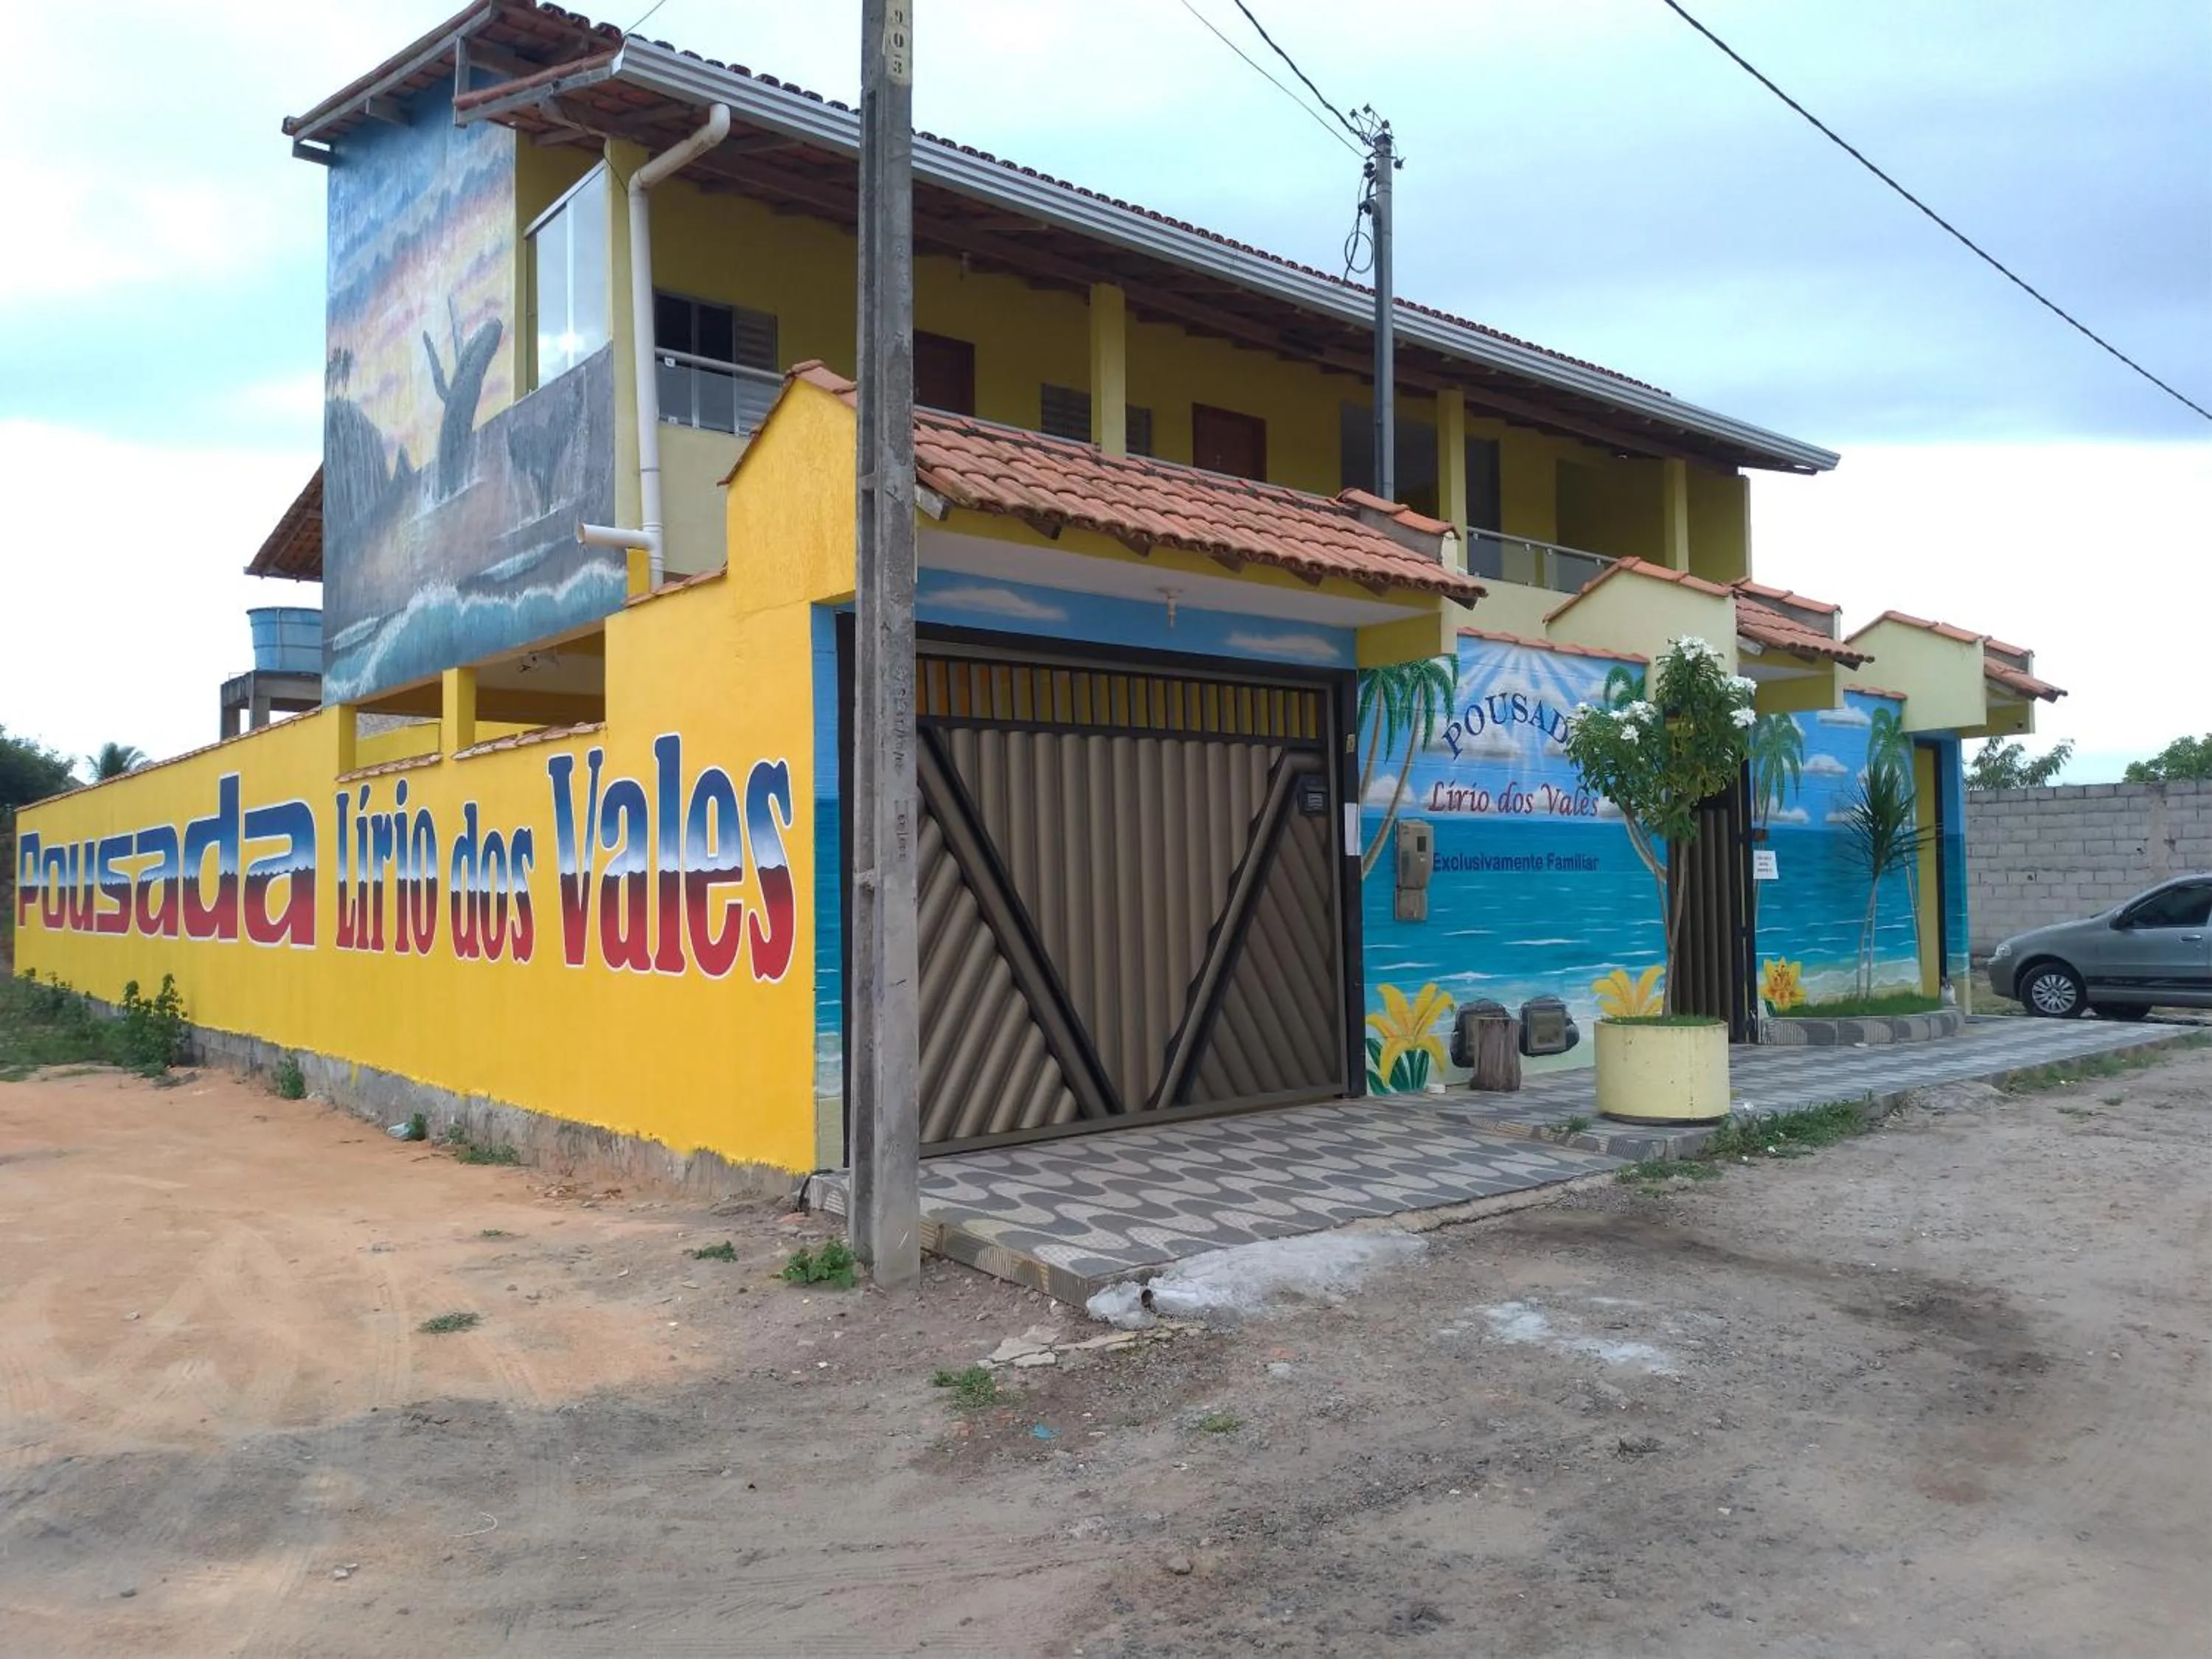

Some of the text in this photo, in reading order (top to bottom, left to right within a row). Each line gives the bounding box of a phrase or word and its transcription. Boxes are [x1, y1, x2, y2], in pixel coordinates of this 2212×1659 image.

[1441, 692, 1569, 761] POUSAD
[1428, 779, 1599, 817] Lírio dos Vales
[16, 731, 797, 984] Pousada Lírio dos Vales
[1433, 852, 1599, 872] Exclusivamente Familiar
